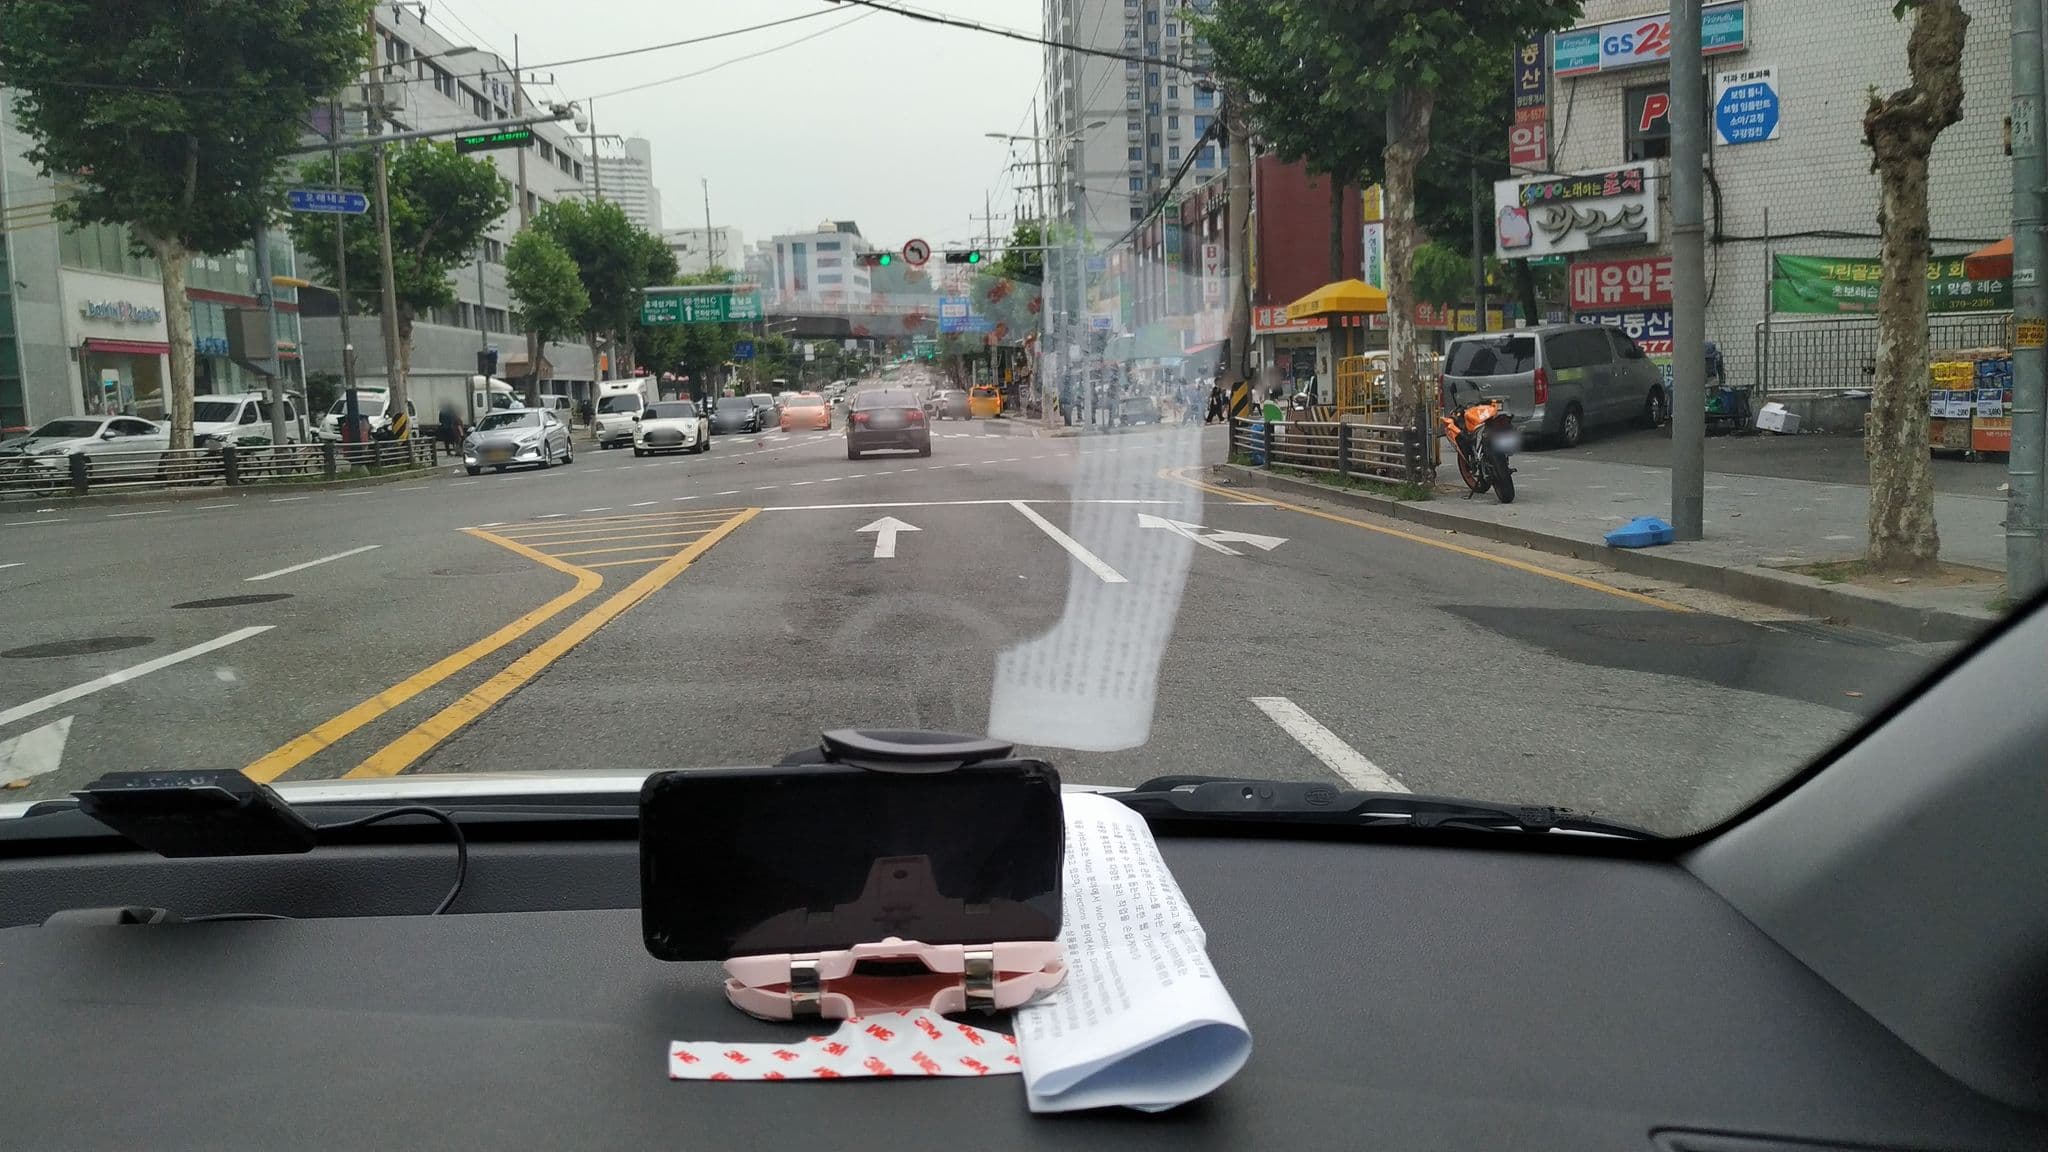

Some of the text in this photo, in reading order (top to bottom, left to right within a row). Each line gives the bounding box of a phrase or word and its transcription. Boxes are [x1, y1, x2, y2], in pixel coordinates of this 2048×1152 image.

[1731, 88, 1746, 99] 보험
[1639, 93, 1671, 131] P
[1511, 125, 1545, 160] 약
[1574, 261, 1673, 303] 대유약국
[866, 1023, 895, 1041] 3M
[914, 1016, 943, 1040] 3M
[957, 1024, 985, 1046] 3M
[723, 1049, 752, 1064] 3M
[822, 1042, 849, 1056] 3M
[911, 1051, 941, 1075] 3M
[960, 1056, 990, 1075] 3M
